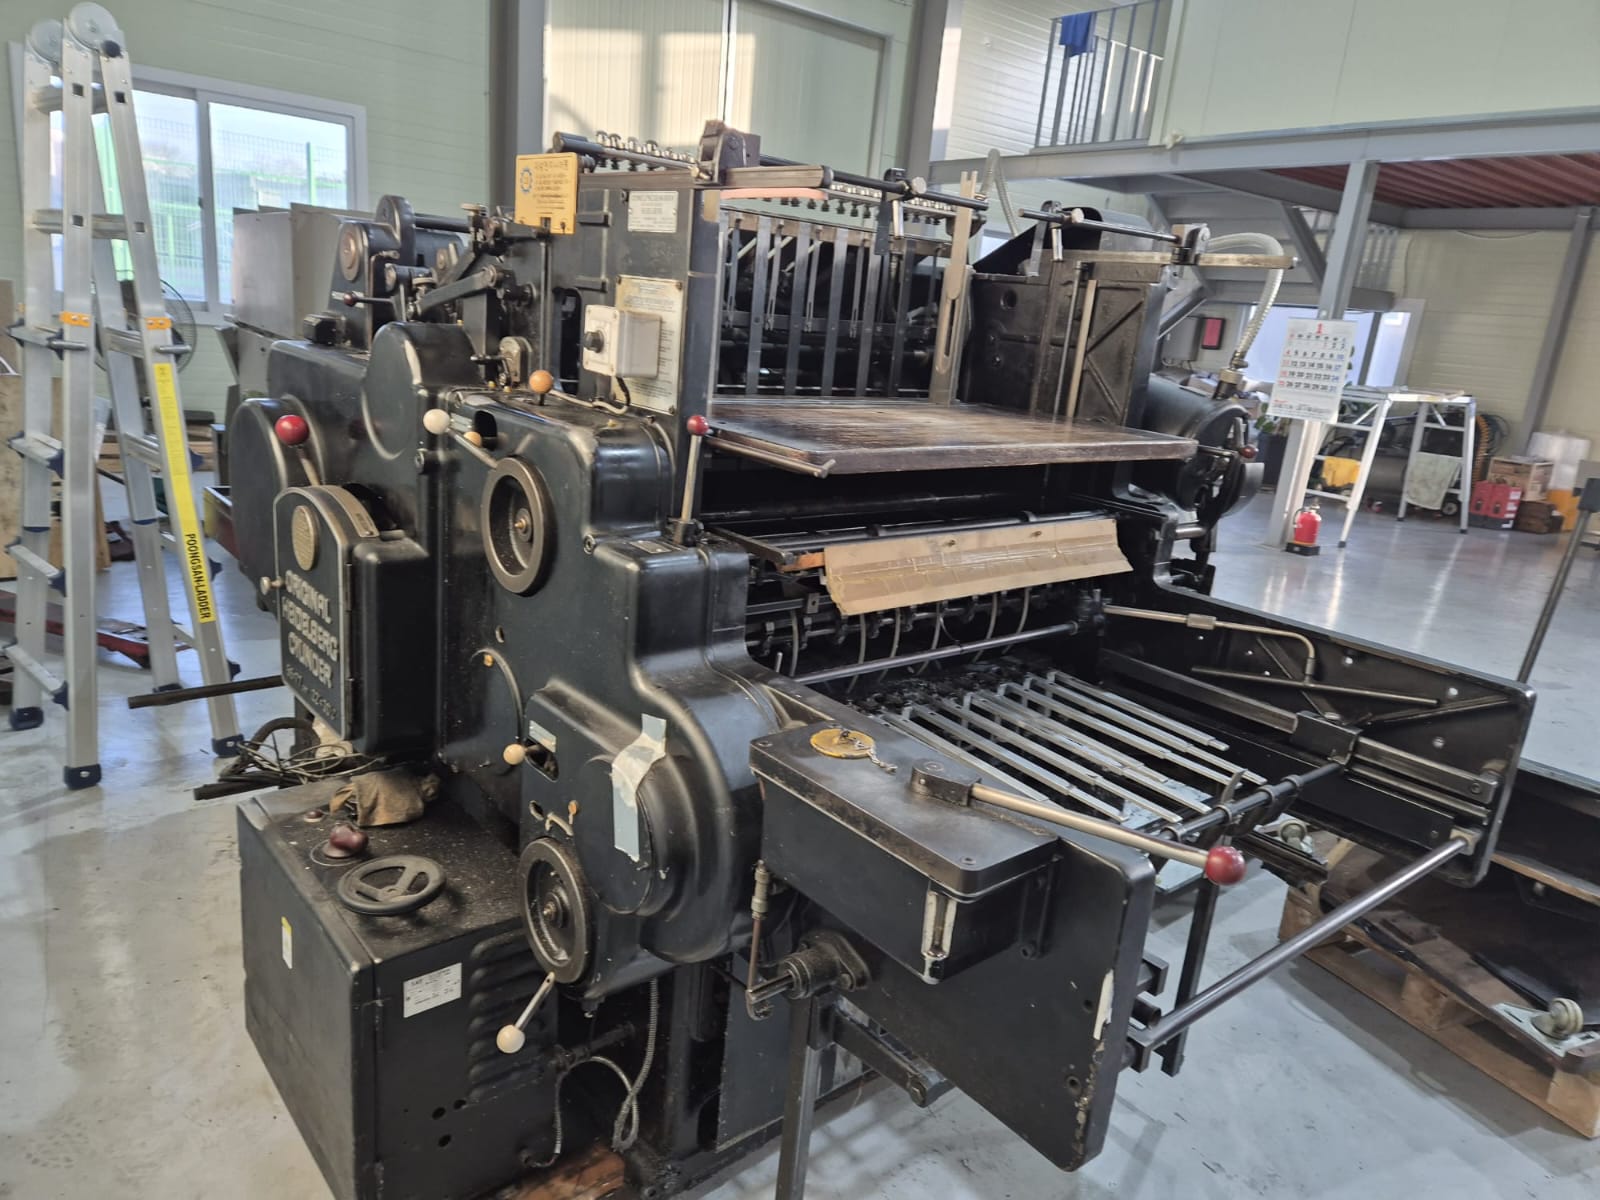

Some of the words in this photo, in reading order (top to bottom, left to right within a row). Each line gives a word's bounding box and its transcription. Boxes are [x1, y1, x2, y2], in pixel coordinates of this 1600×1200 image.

[286, 570, 332, 624] ORIGINAL
[282, 596, 338, 662] HEIDELBERG
[288, 632, 332, 688] CYLINDER
